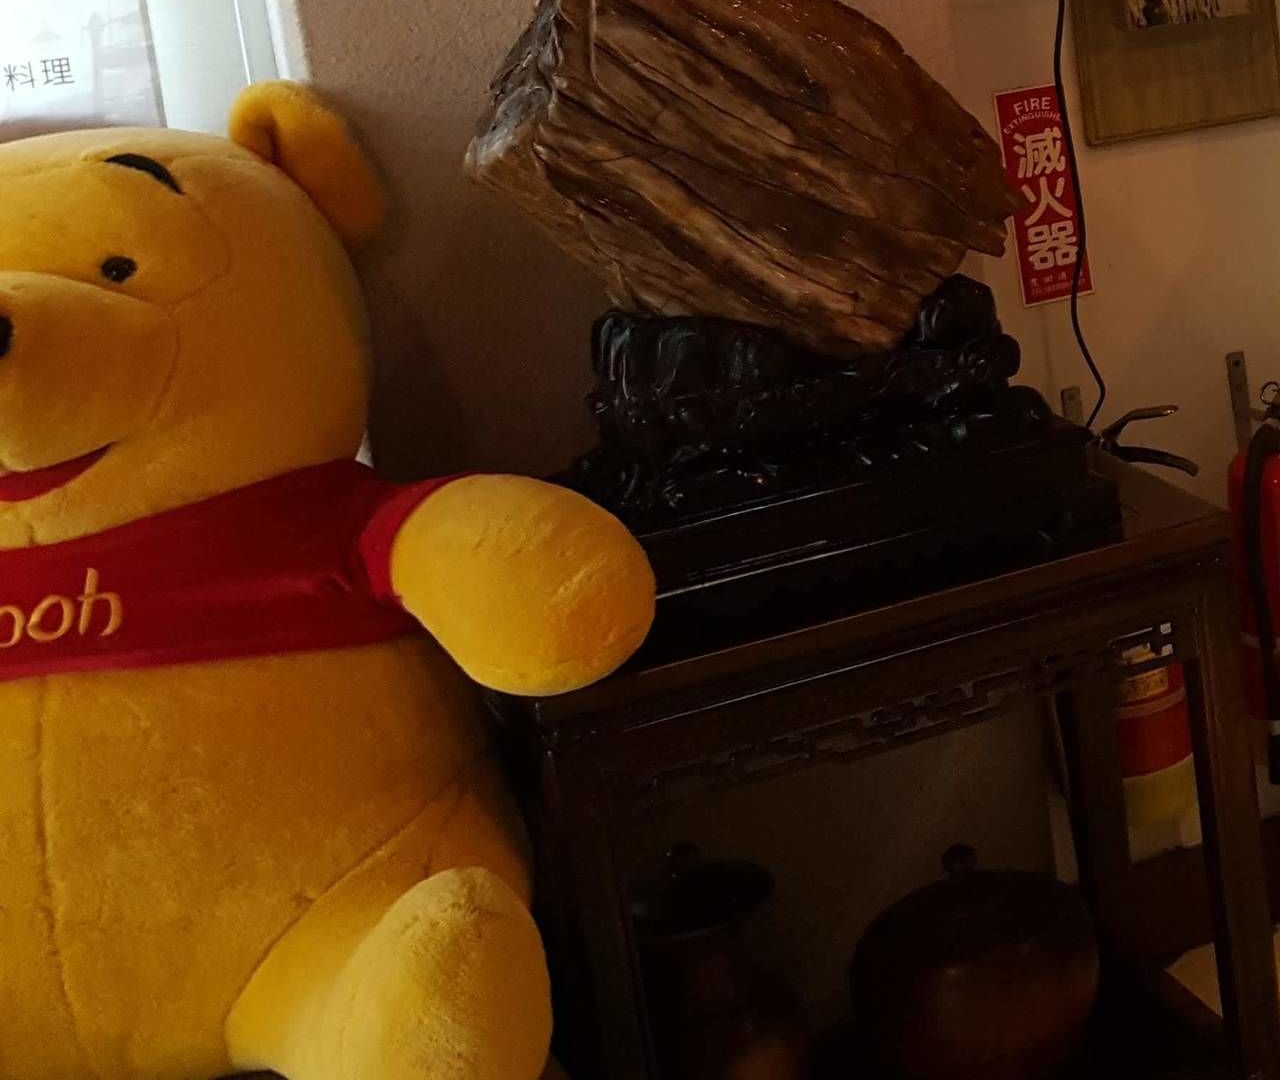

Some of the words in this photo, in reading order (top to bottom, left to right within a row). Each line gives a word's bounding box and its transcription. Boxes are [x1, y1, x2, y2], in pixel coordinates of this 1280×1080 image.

[2, 58, 76, 91] 料理
[1013, 96, 1051, 116] FIRE
[1003, 112, 1062, 136] EXTINGUISHE
[1013, 126, 1079, 271] 滅火器
